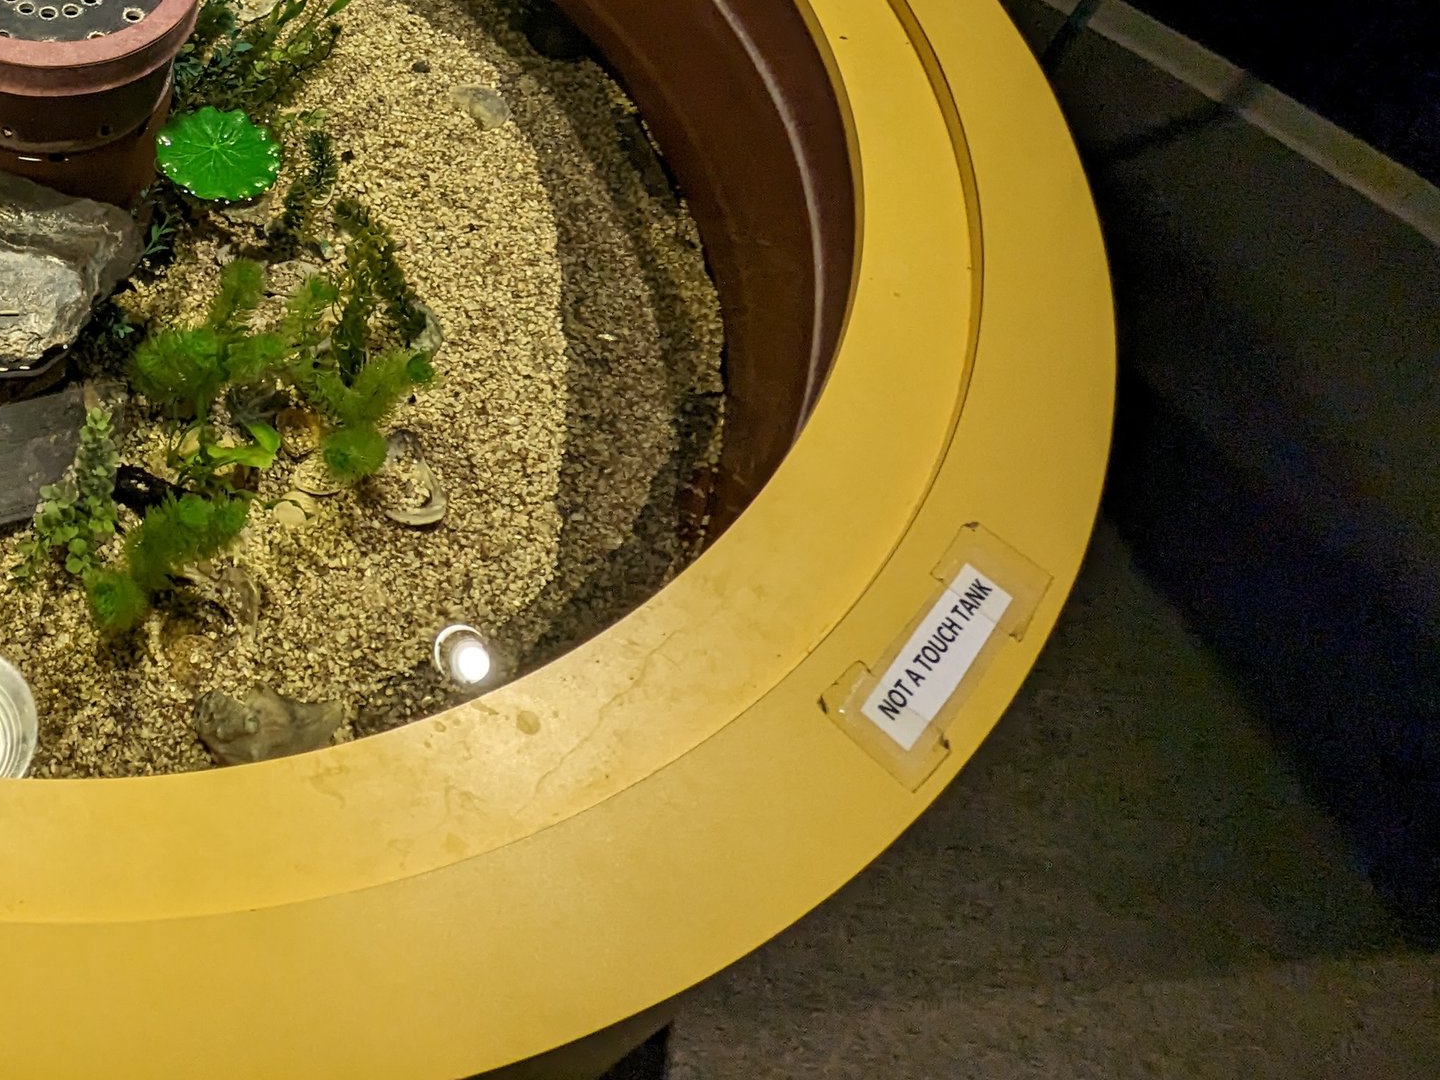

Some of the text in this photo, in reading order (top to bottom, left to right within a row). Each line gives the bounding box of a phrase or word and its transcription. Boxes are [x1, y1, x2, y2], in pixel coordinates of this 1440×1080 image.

[877, 578, 993, 721] NOT A TOUCH TANK
